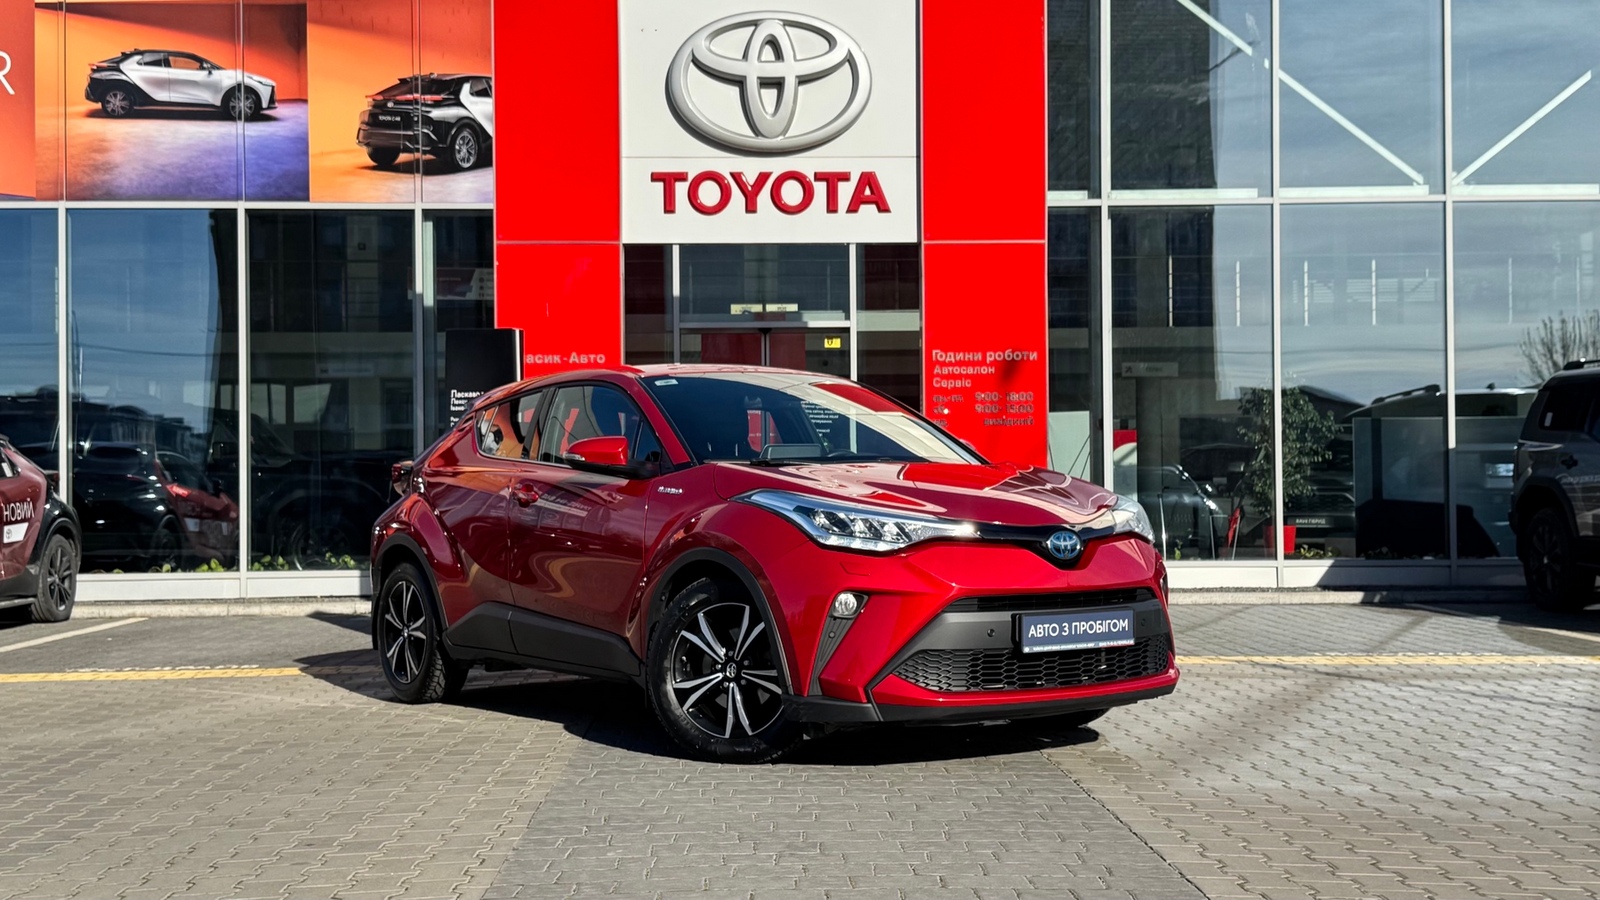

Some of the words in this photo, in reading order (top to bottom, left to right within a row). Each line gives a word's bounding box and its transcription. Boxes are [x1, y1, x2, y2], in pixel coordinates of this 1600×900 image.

[650, 170, 892, 215] TOYOTA
[526, 352, 606, 364] асик-Авто
[932, 350, 982, 363] Години
[986, 349, 1038, 364] роботи
[933, 365, 995, 375] Автосалон
[933, 377, 972, 389] Сервіс
[4, 499, 35, 521] НОВИЙ
[1028, 624, 1060, 638] АВТО
[1071, 618, 1129, 635] ПРОБІГОМ
